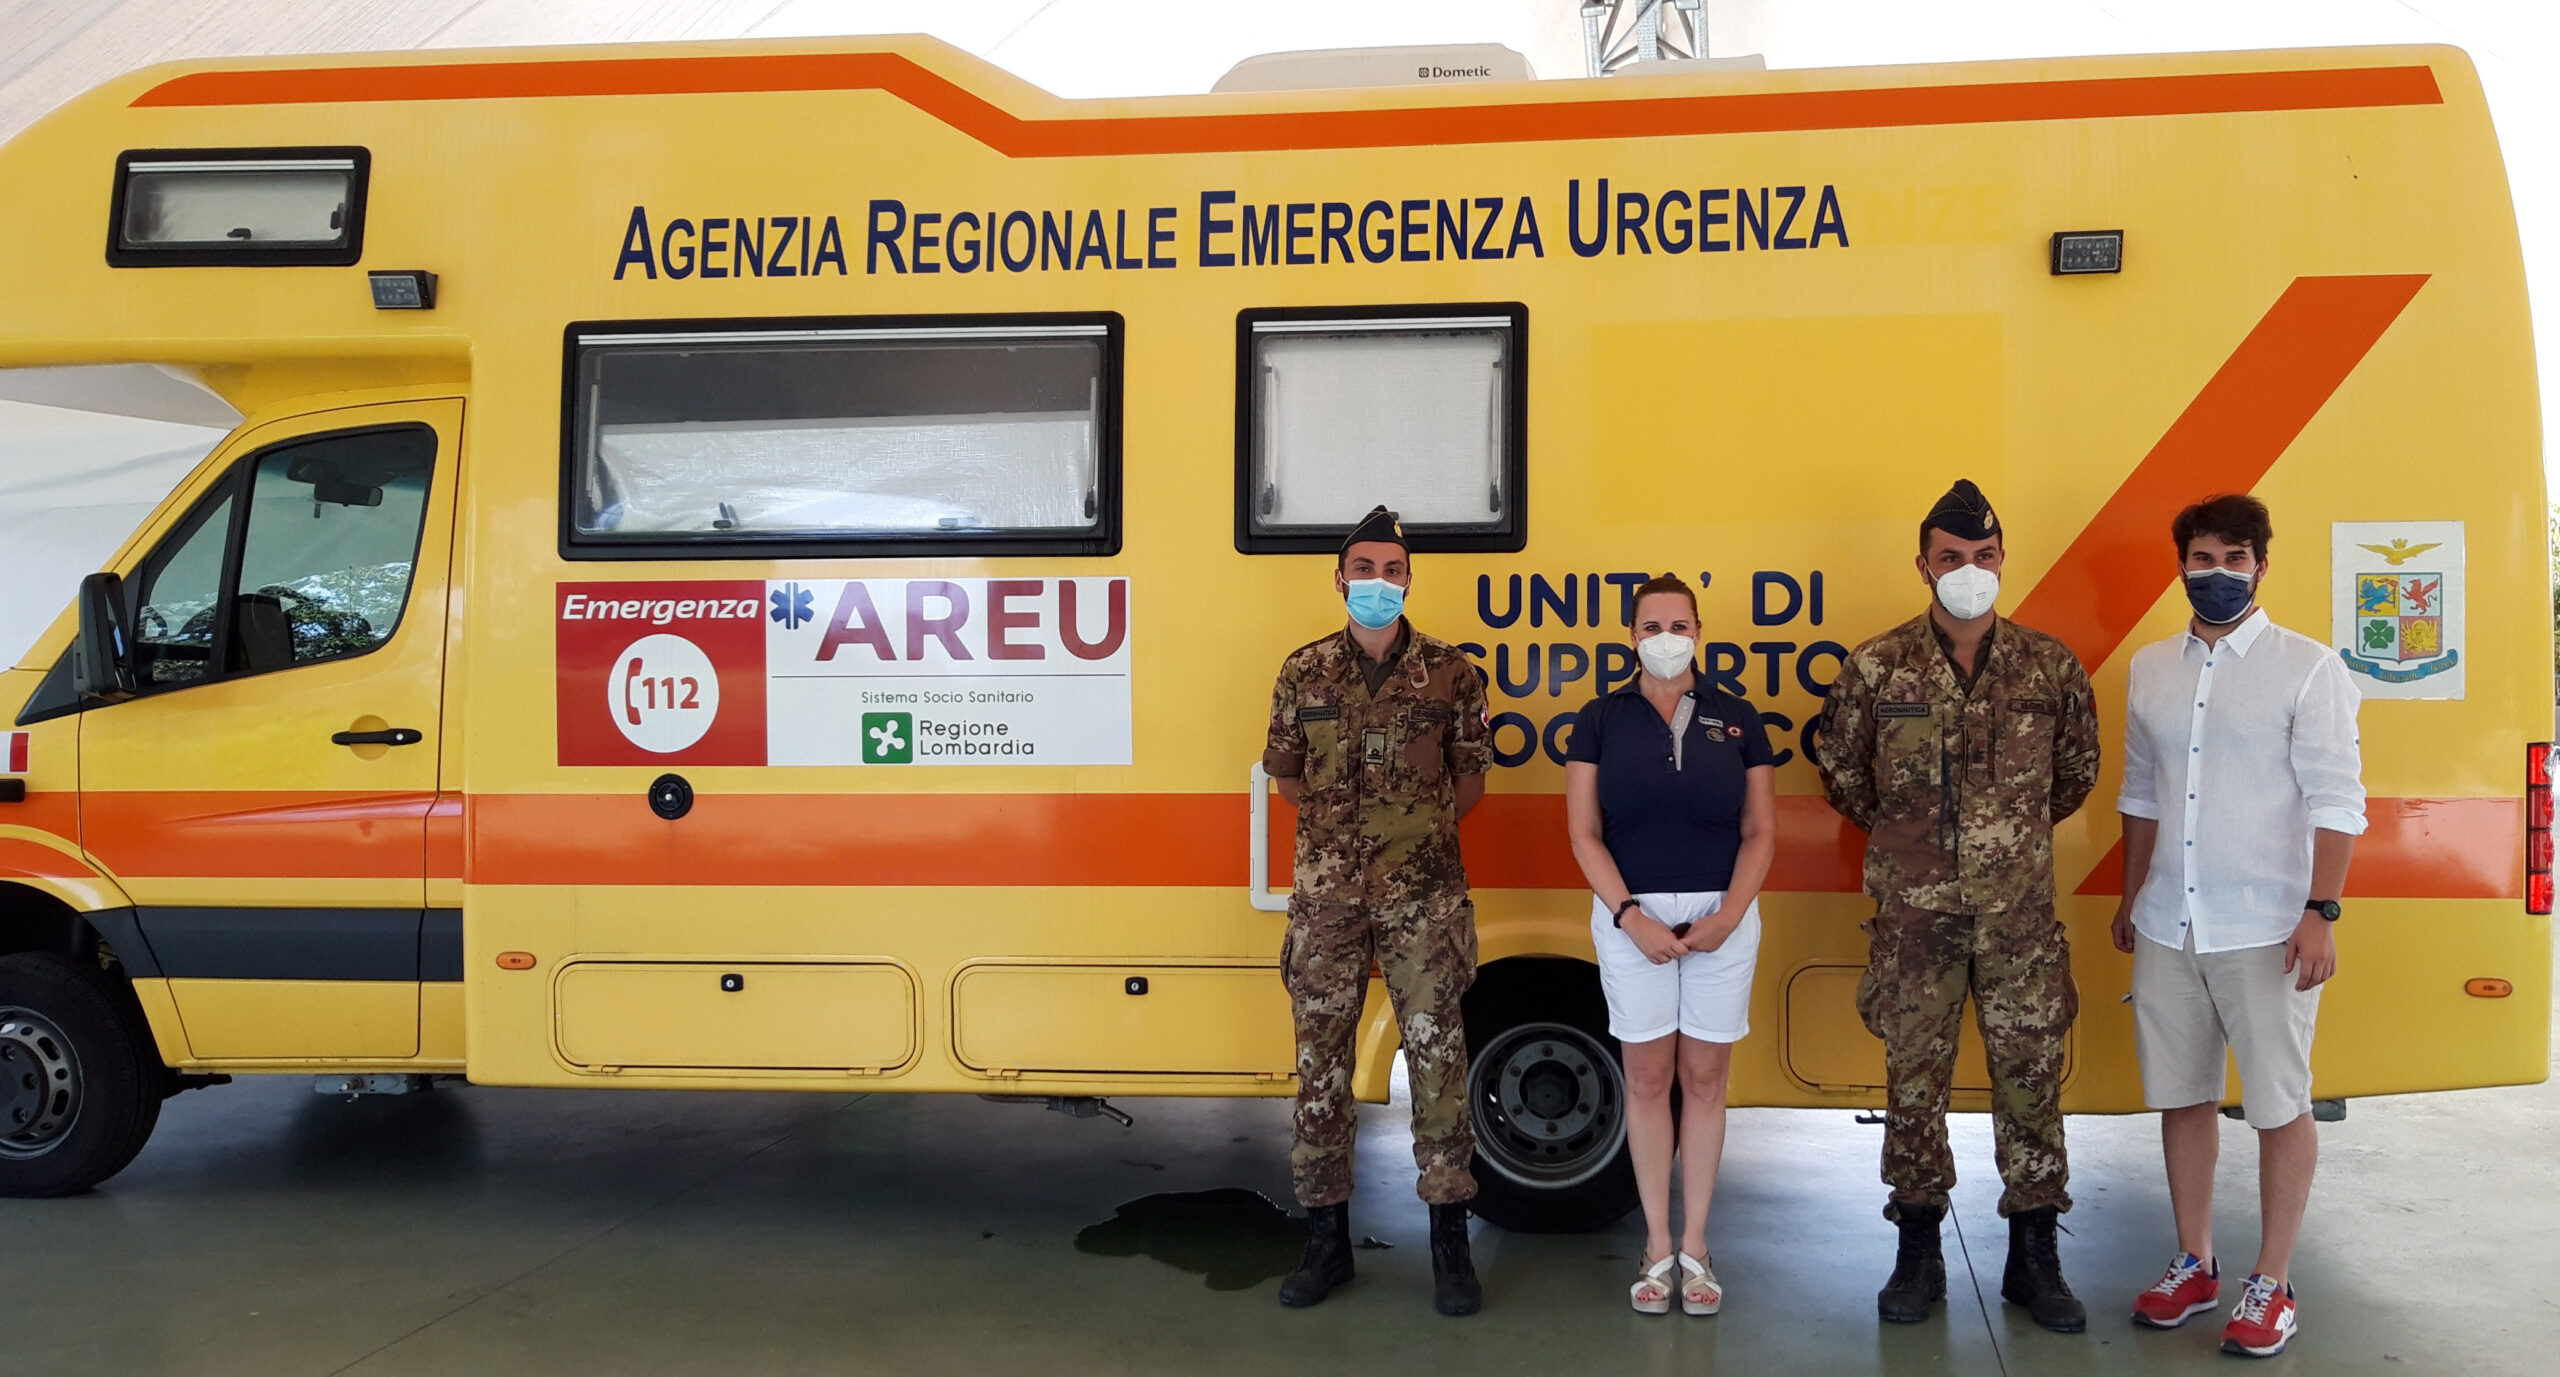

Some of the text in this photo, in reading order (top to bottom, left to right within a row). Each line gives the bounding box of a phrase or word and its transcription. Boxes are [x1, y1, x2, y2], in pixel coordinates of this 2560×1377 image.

[1432, 65, 1492, 78] Dometic
[613, 205, 848, 281] AGENZIA
[866, 199, 1177, 275] REGIONALE
[1199, 190, 1545, 268] EMERGENZA
[1568, 178, 1850, 258] URGENZA
[562, 593, 759, 626] Emergenza
[1477, 569, 1825, 630] UNIT' DI
[813, 579, 1127, 662] AREU
[1454, 640, 1849, 698] UPPRTO
[641, 676, 699, 710] 112
[861, 690, 1035, 704] Sistema Socio Sanitario
[919, 719, 1010, 741] Regione
[919, 738, 1035, 756] Lombardia
